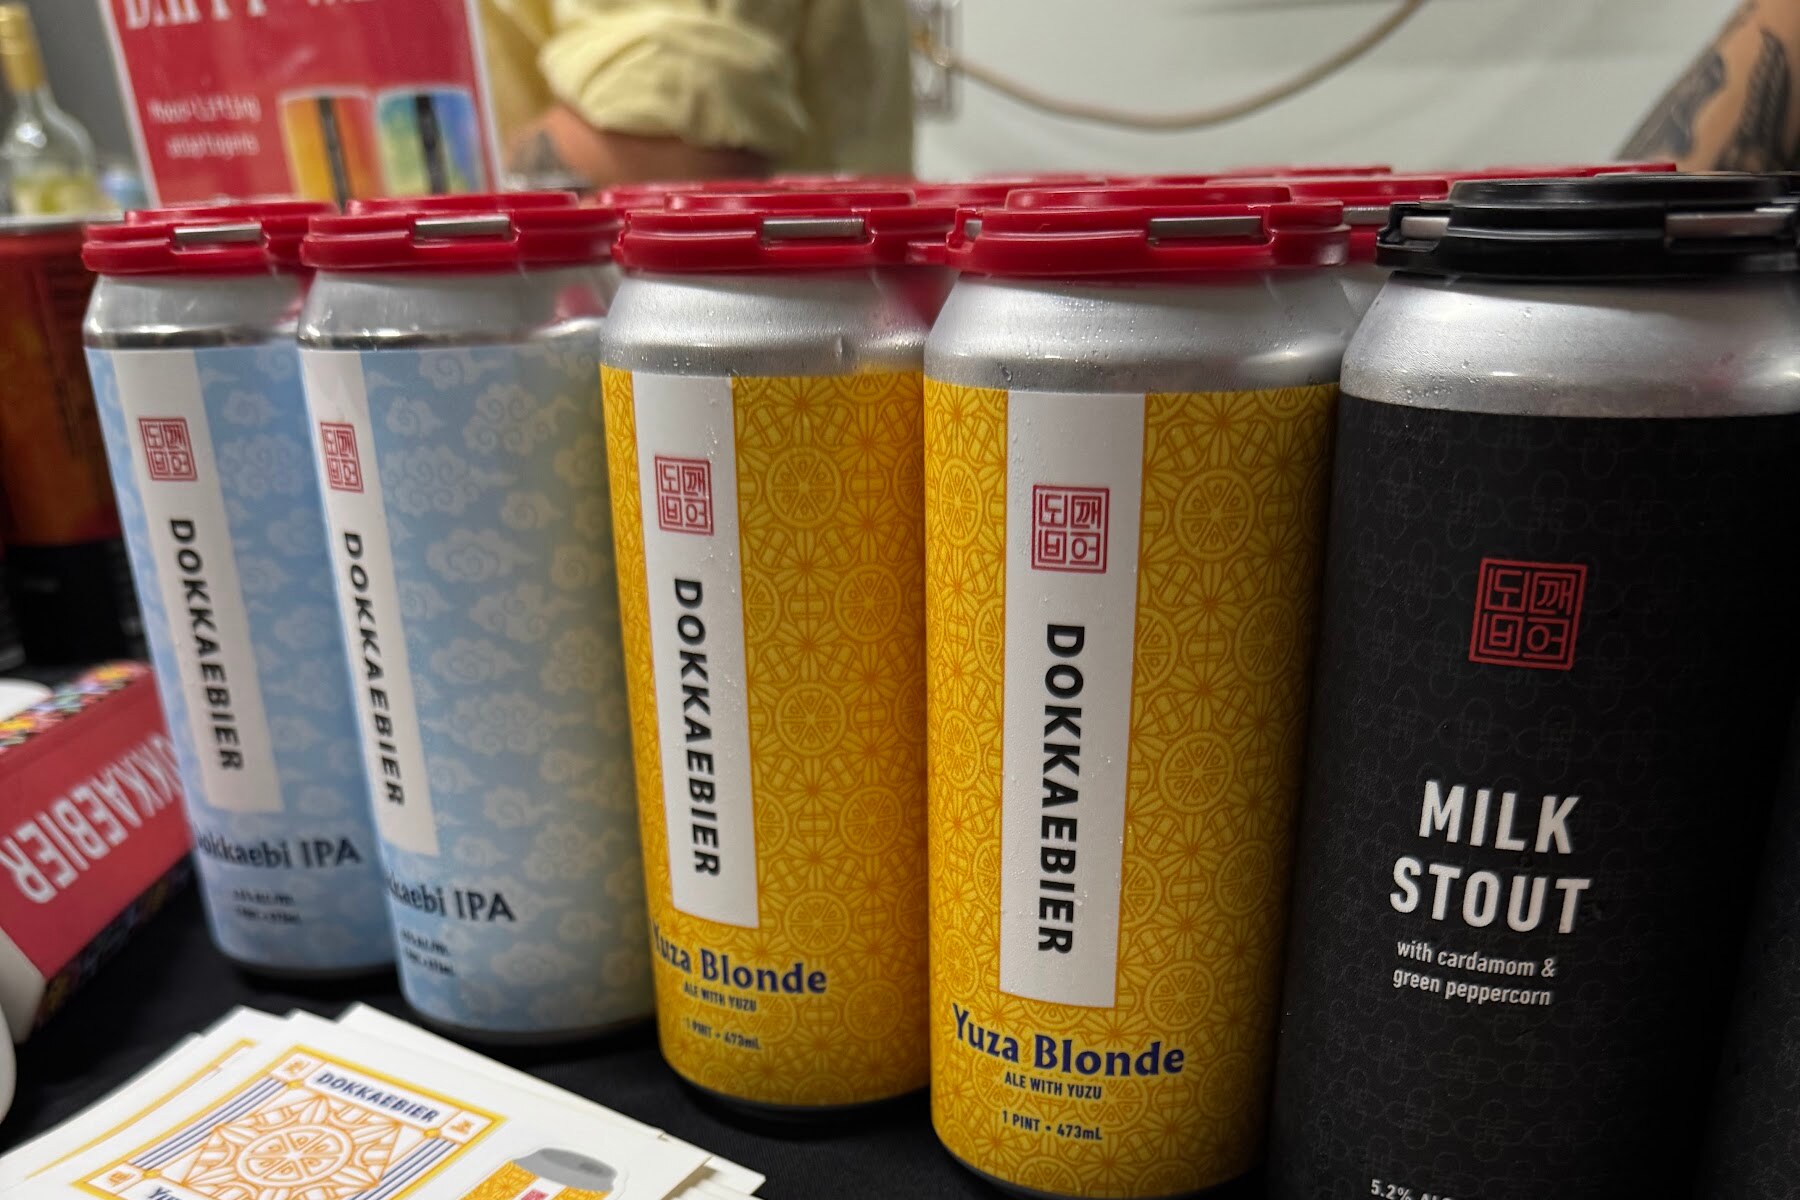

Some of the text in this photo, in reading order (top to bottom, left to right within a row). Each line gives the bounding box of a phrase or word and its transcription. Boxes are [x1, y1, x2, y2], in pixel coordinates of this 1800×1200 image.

[170, 518, 244, 771] DOKKAEBIER
[344, 531, 405, 806] DOKKAEBIER
[673, 577, 721, 878] DOKKAEBIER
[1038, 623, 1085, 955] DOKKAEBIER
[1419, 779, 1580, 854] MILK
[300, 836, 364, 868] IPA
[455, 887, 518, 922] IPA
[1389, 856, 1592, 934] STOUT
[651, 920, 828, 994] Yuza Blonde
[1392, 968, 1551, 1006] green peppercorn
[1397, 940, 1556, 978] with cardamom &
[701, 987, 726, 1007] WITH
[728, 994, 758, 1013] YUZU
[952, 1002, 1185, 1077] Yuza Blonde
[316, 1069, 442, 1126] DOKKAEBIER
[1004, 1071, 1102, 1100] ALE WITH YUZU
[1002, 1110, 1103, 1141] 1 PINT 473mL
